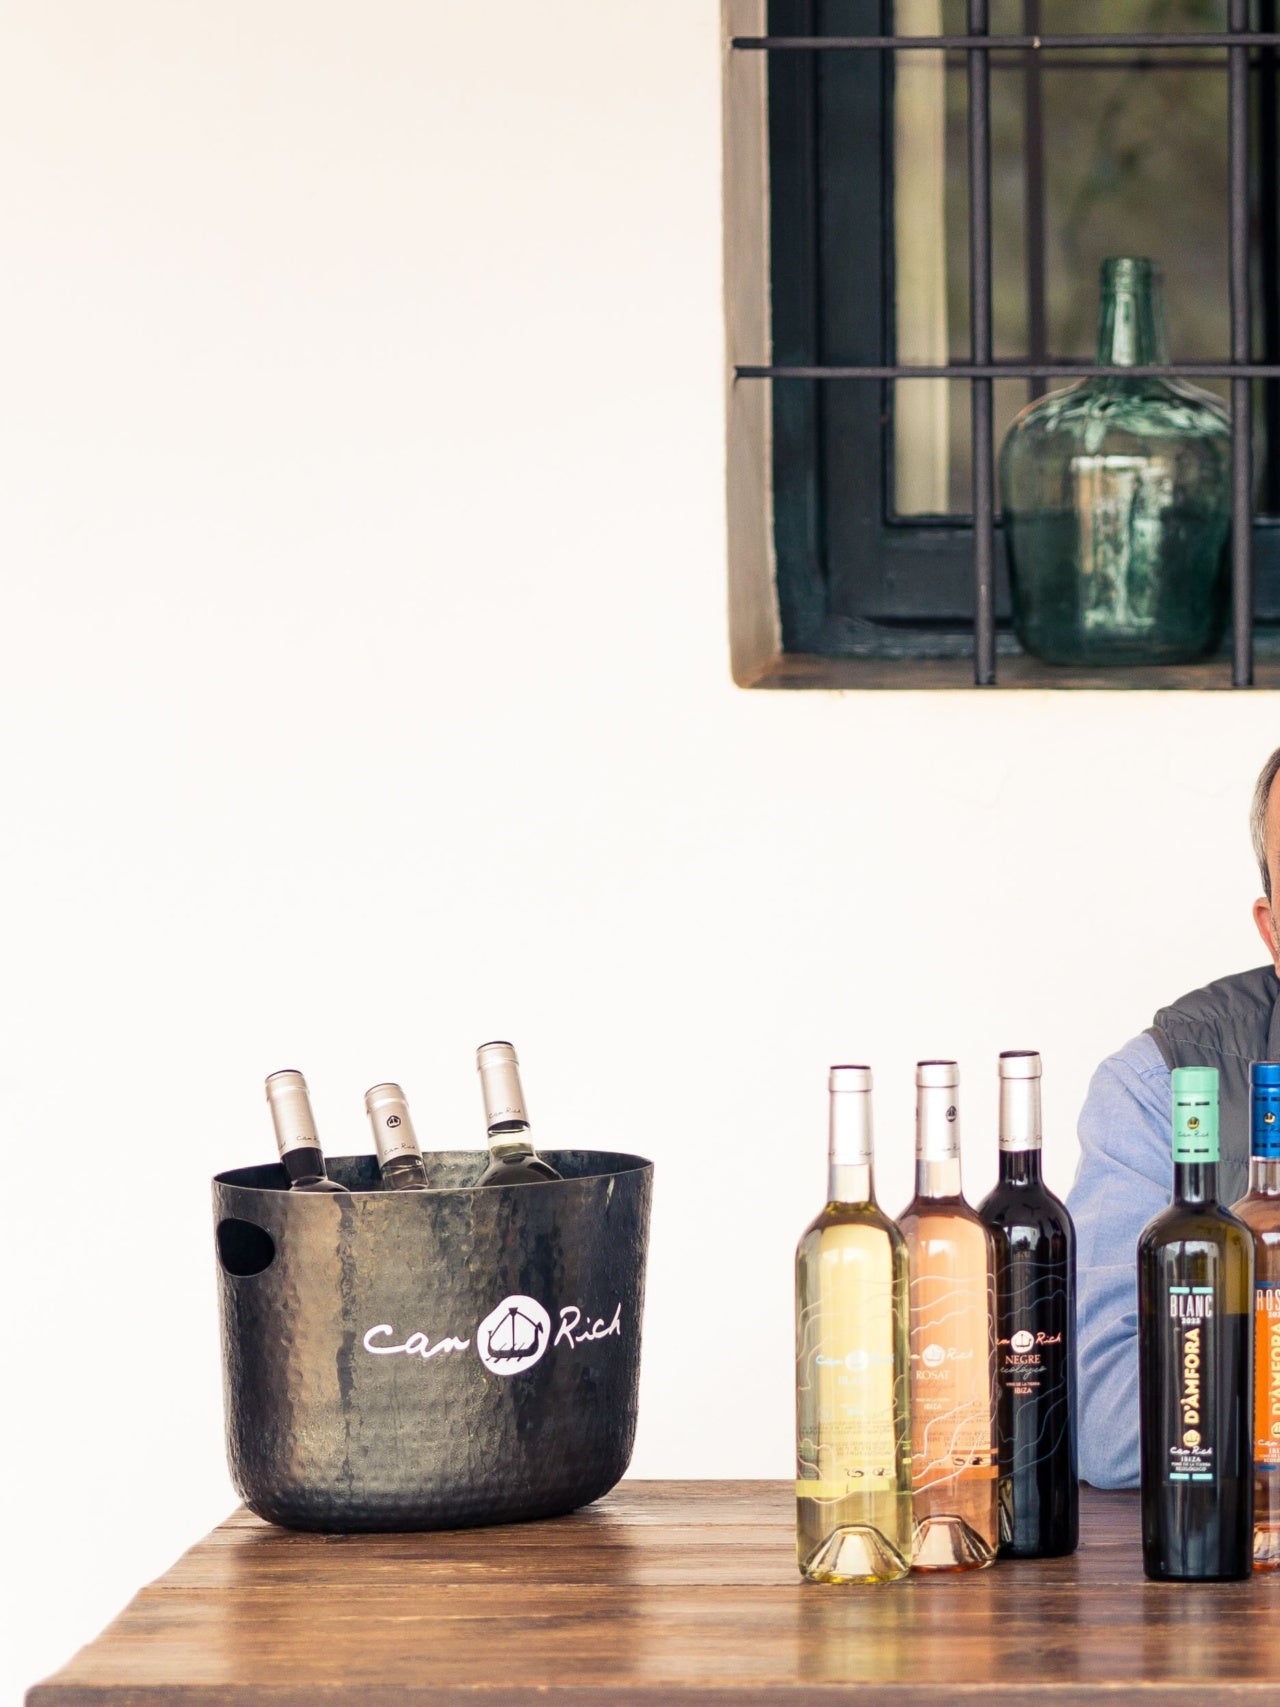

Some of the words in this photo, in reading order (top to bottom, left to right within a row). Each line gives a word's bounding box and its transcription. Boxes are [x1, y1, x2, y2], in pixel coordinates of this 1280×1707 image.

[1170, 1295, 1213, 1318] BLANC
[363, 1324, 470, 1358] Can
[554, 1302, 621, 1349] Rich
[1035, 1331, 1062, 1345] Rich
[1005, 1354, 1041, 1365] NEGRE
[916, 1370, 951, 1380] ROSAT
[1257, 1438, 1278, 1447] Can
[1169, 1446, 1190, 1455] Can
[1191, 1445, 1213, 1455] Rich
